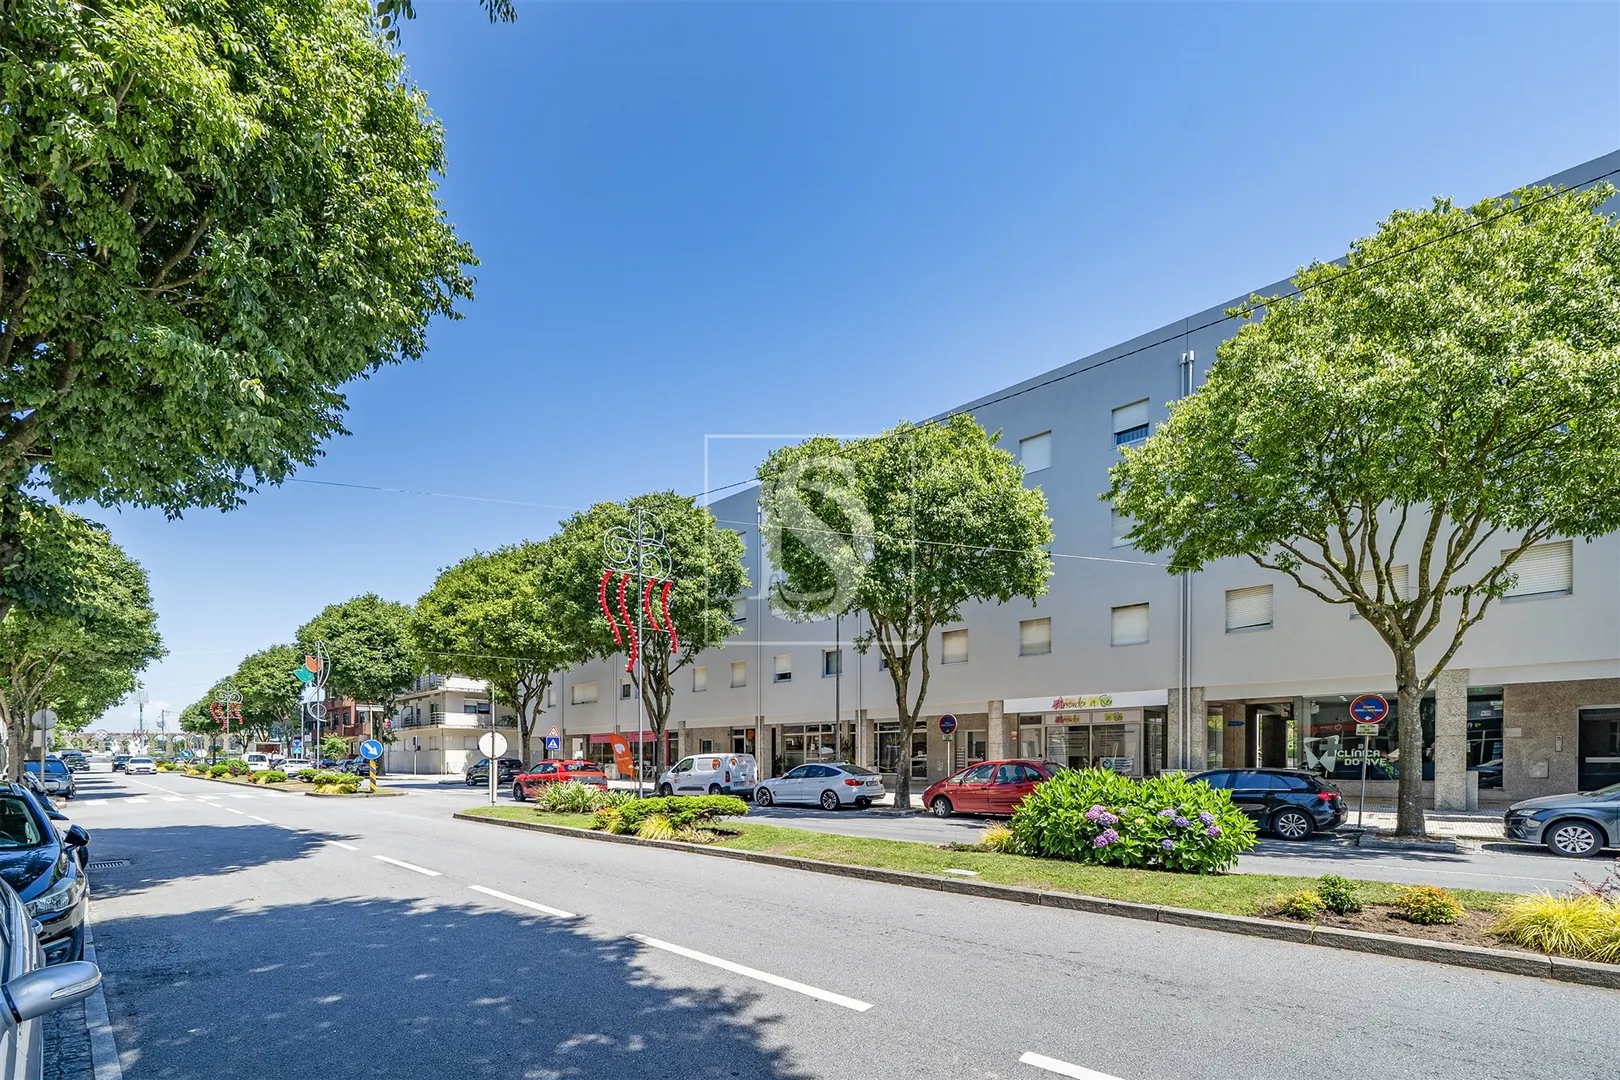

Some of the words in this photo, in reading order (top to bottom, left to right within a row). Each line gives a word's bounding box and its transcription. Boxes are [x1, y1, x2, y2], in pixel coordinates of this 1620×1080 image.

[1337, 748, 1380, 757] CLÍNICA
[1344, 758, 1360, 766] DO
[1365, 758, 1387, 766] AVE
